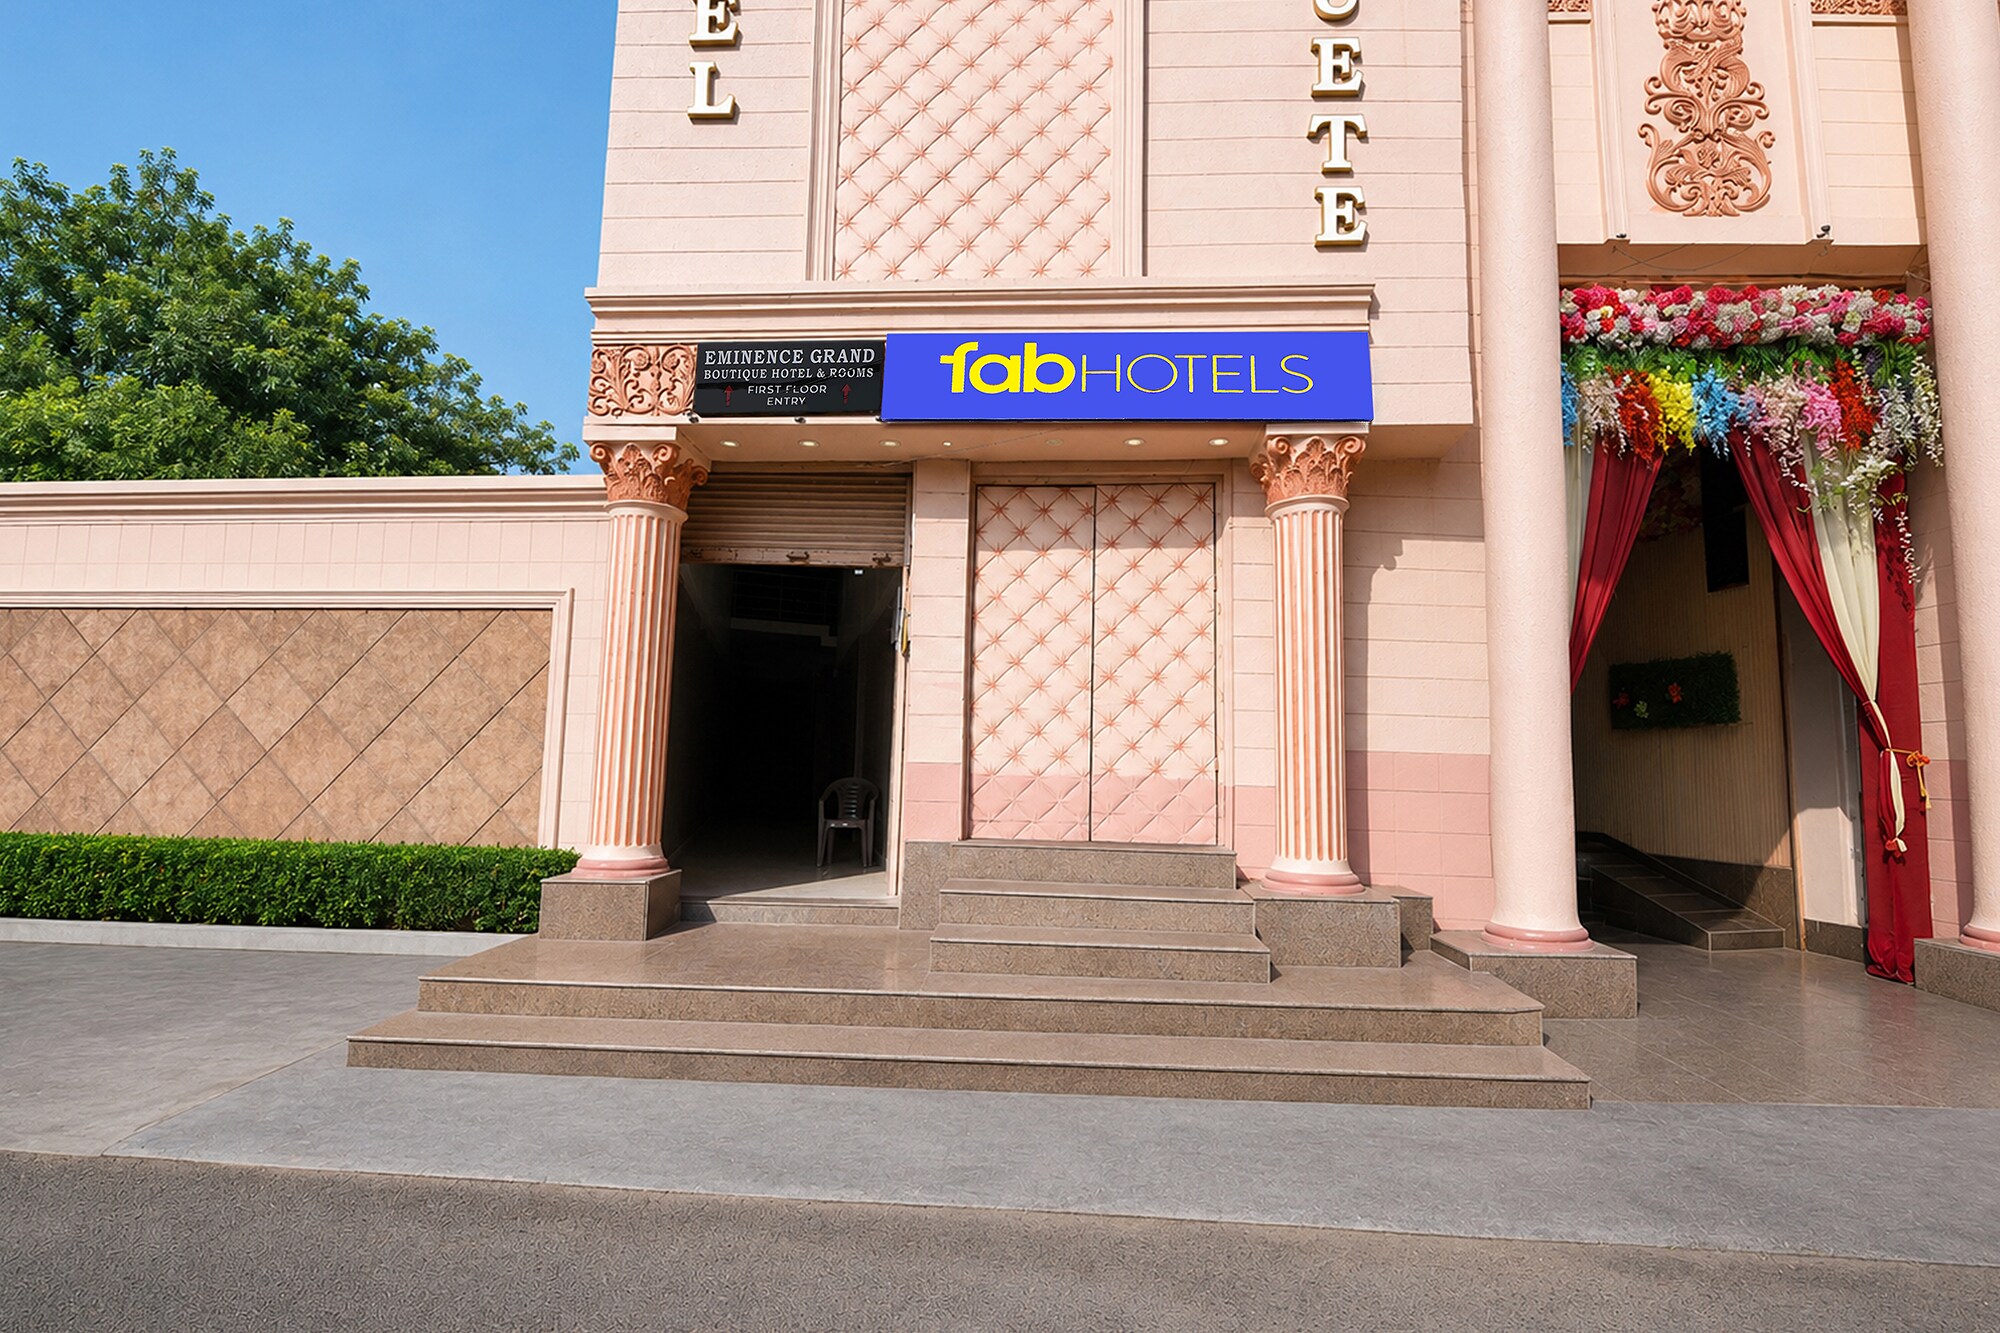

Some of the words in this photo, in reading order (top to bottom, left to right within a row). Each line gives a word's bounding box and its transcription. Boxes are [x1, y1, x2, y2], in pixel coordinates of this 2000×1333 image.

[704, 349, 804, 365] EMINENCE
[810, 348, 876, 364] GRAND
[703, 368, 768, 382] BOUTIQUE
[771, 368, 813, 379] HOTEL
[816, 368, 826, 379] &
[829, 367, 874, 378] ROOMS
[747, 385, 781, 395] FIRST
[785, 384, 827, 394] FLOOR
[766, 397, 806, 406] ENTRY
